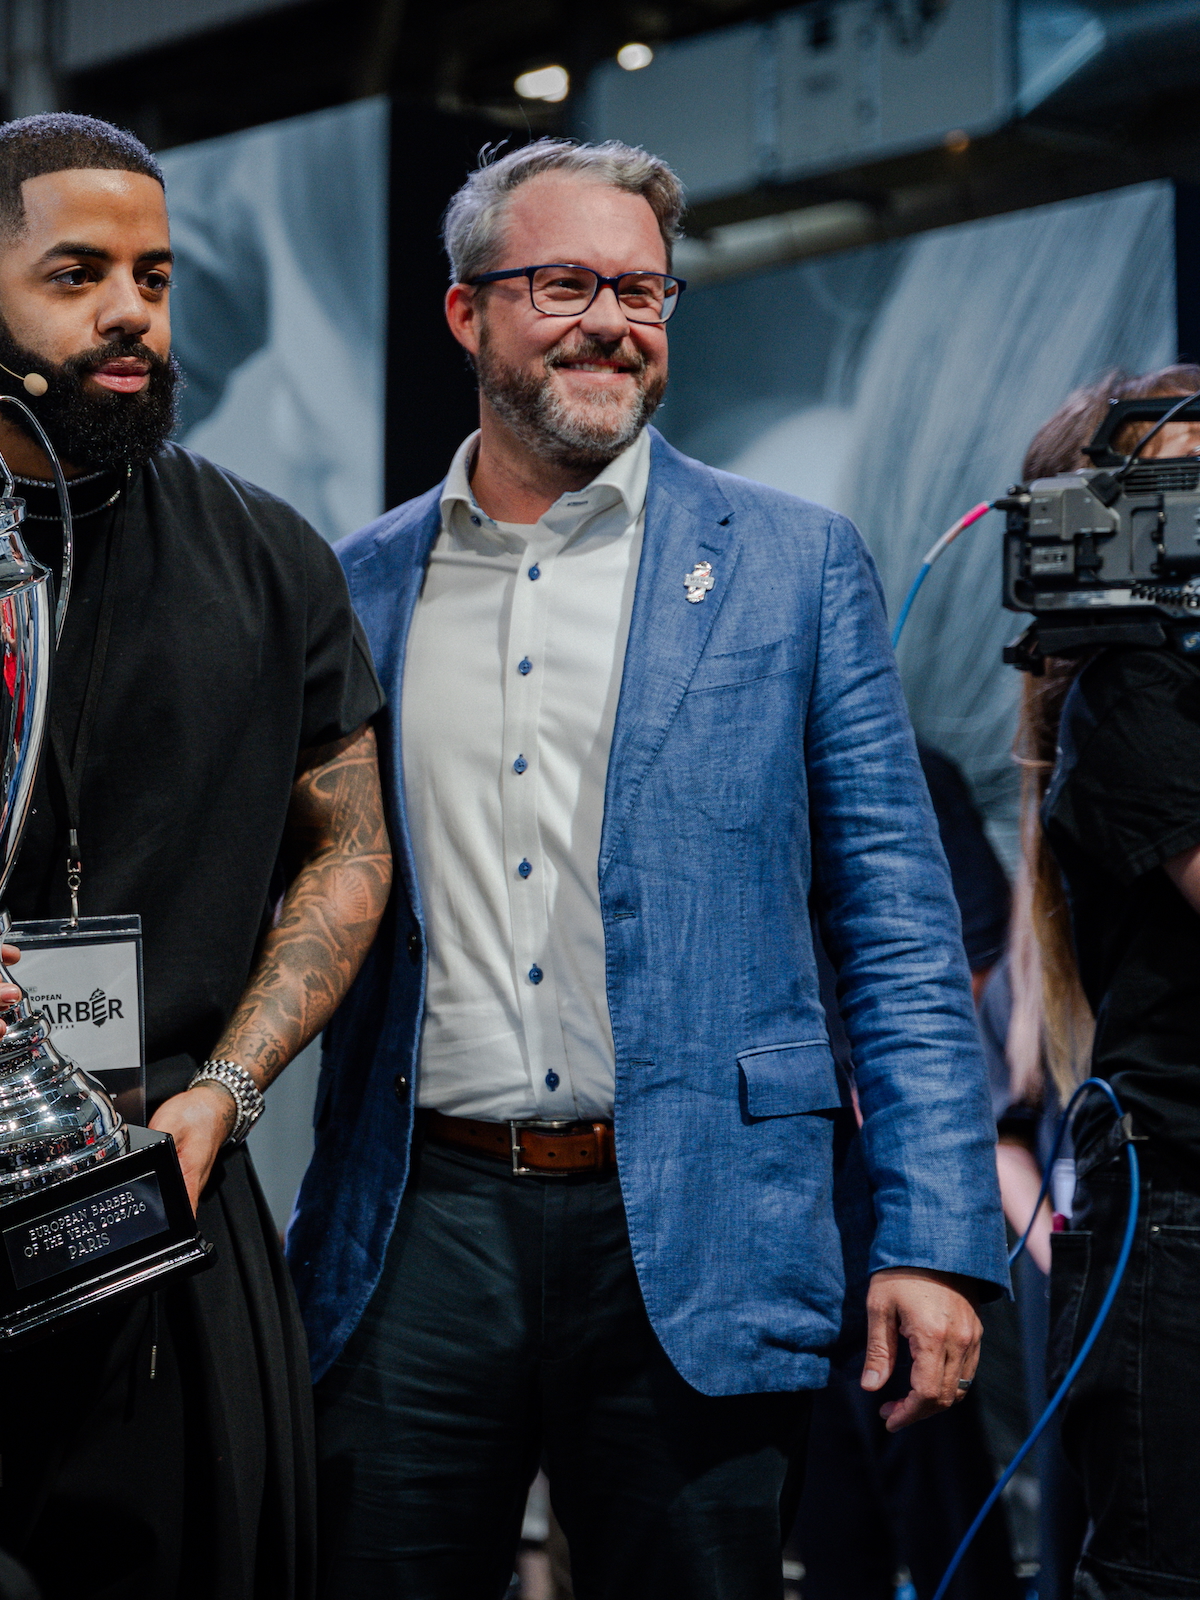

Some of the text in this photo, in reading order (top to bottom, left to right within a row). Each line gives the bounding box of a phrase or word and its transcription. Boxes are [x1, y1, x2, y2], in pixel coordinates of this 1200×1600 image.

[42, 990, 125, 1027] ARBER
[24, 1201, 147, 1258] OF THE YEAR 2025/26
[29, 1191, 135, 1241] EUROPEAN BARBER
[68, 1232, 111, 1260] PARIS
